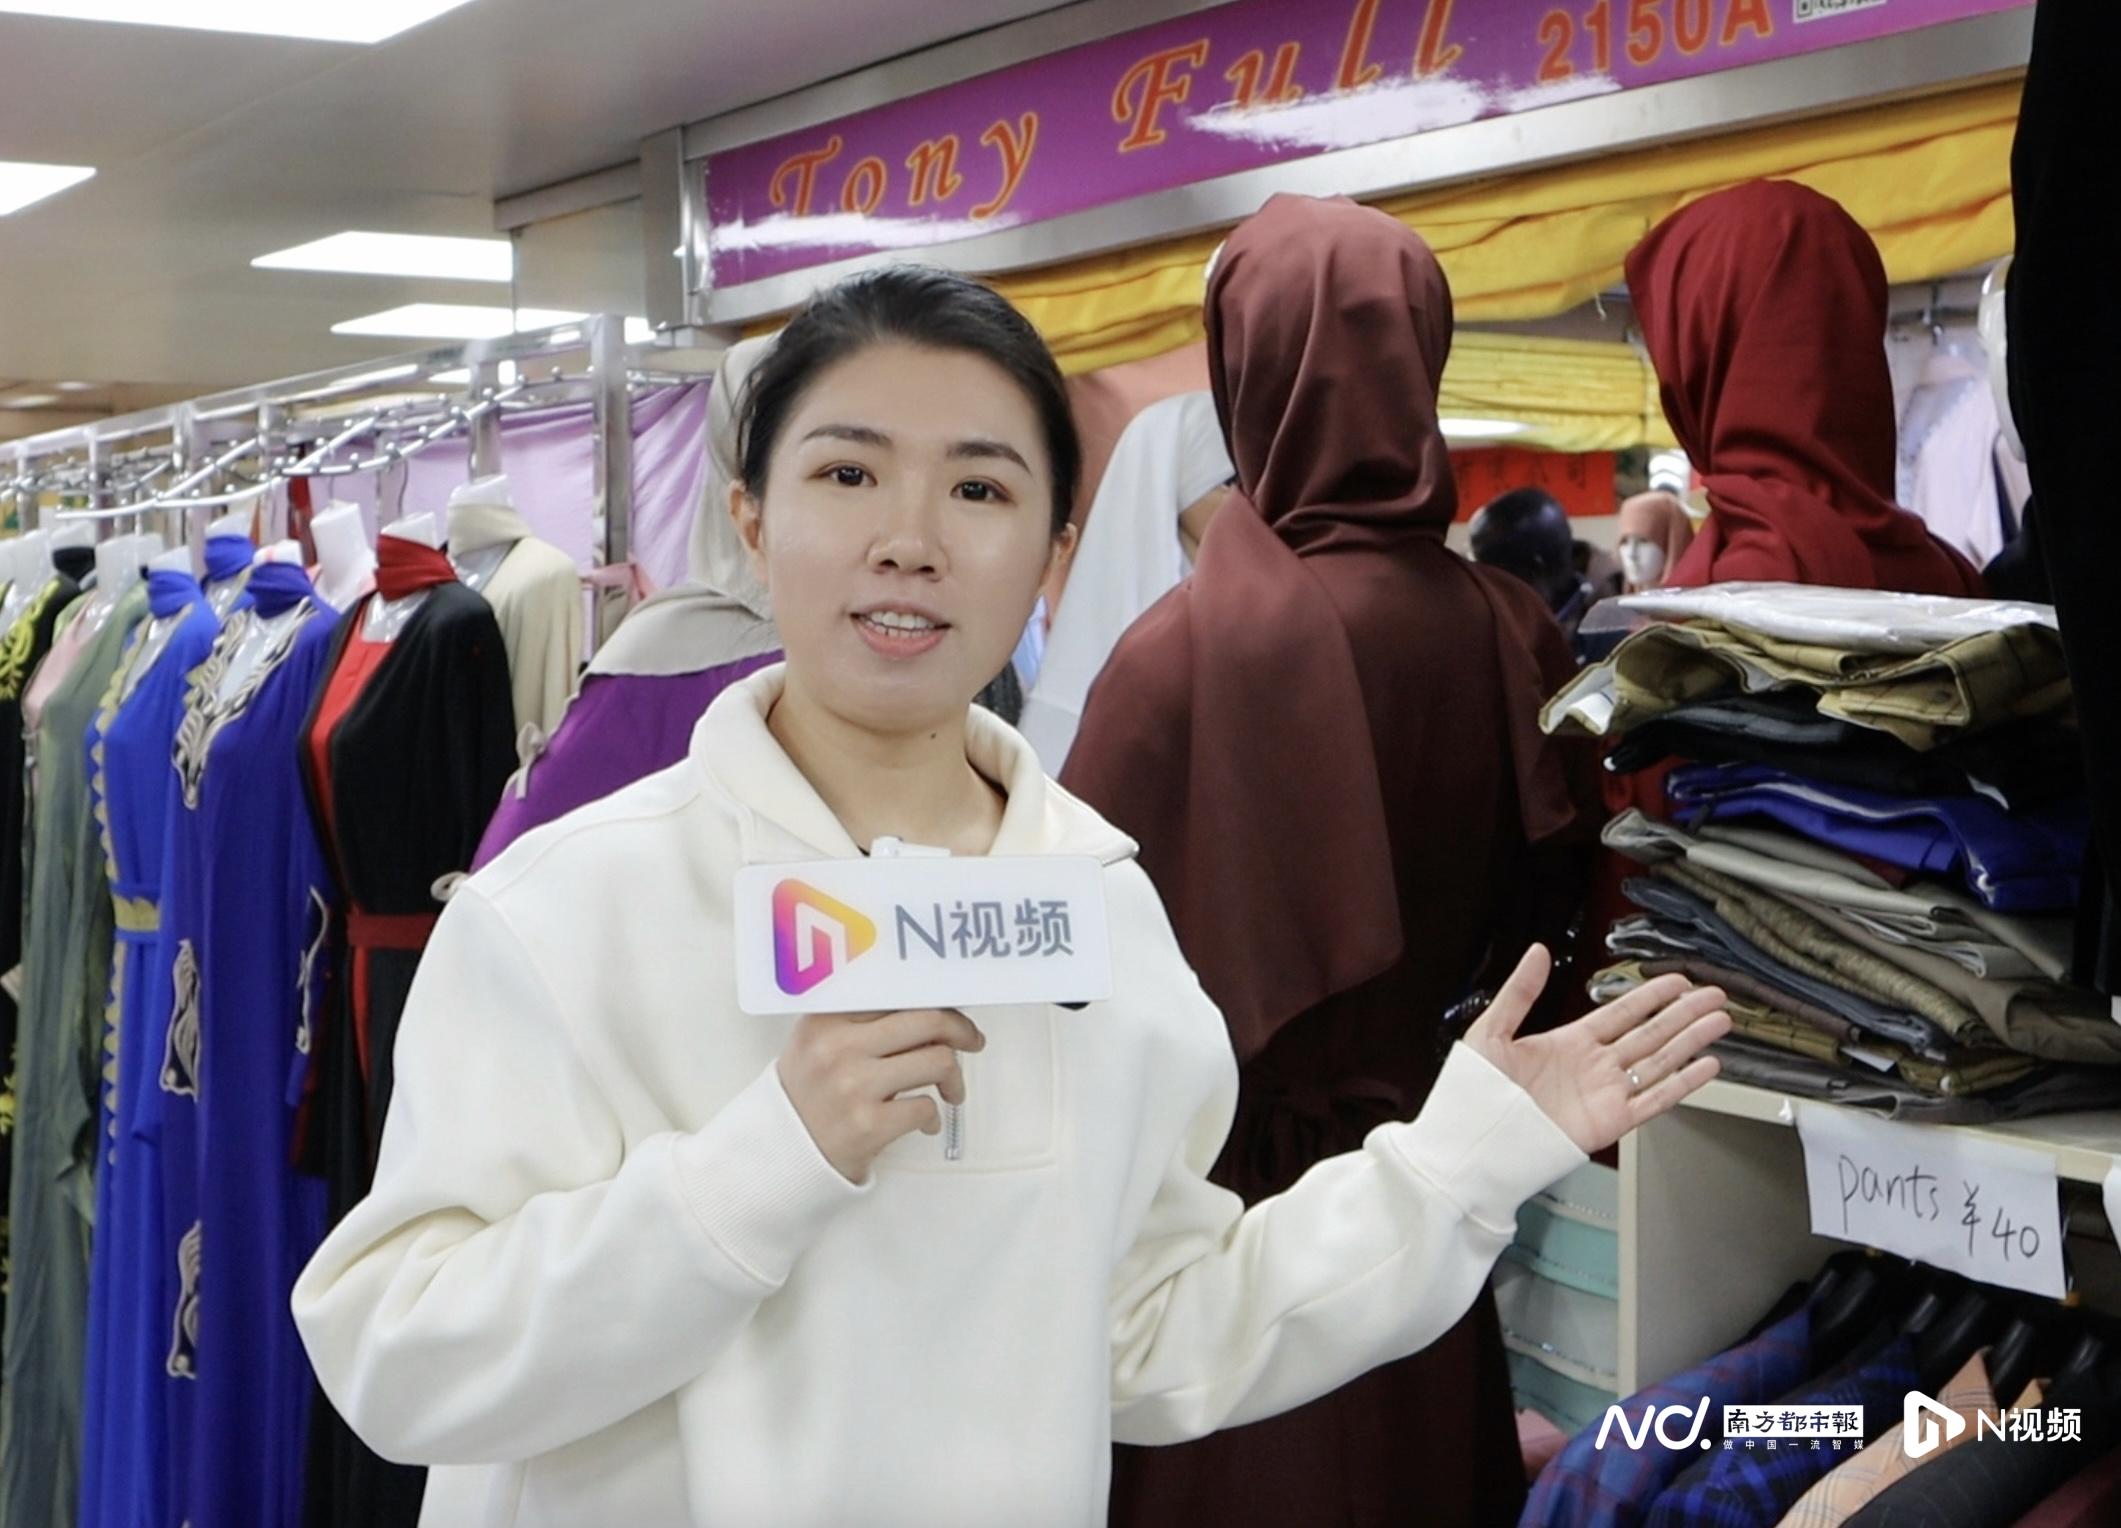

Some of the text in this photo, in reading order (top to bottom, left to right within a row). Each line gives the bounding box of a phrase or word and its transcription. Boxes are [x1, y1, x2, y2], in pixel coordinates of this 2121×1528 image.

[769, 0, 1774, 221] Tony Full 2150A
[895, 898, 1075, 961] N视频
[1838, 1154, 1940, 1235] pants
